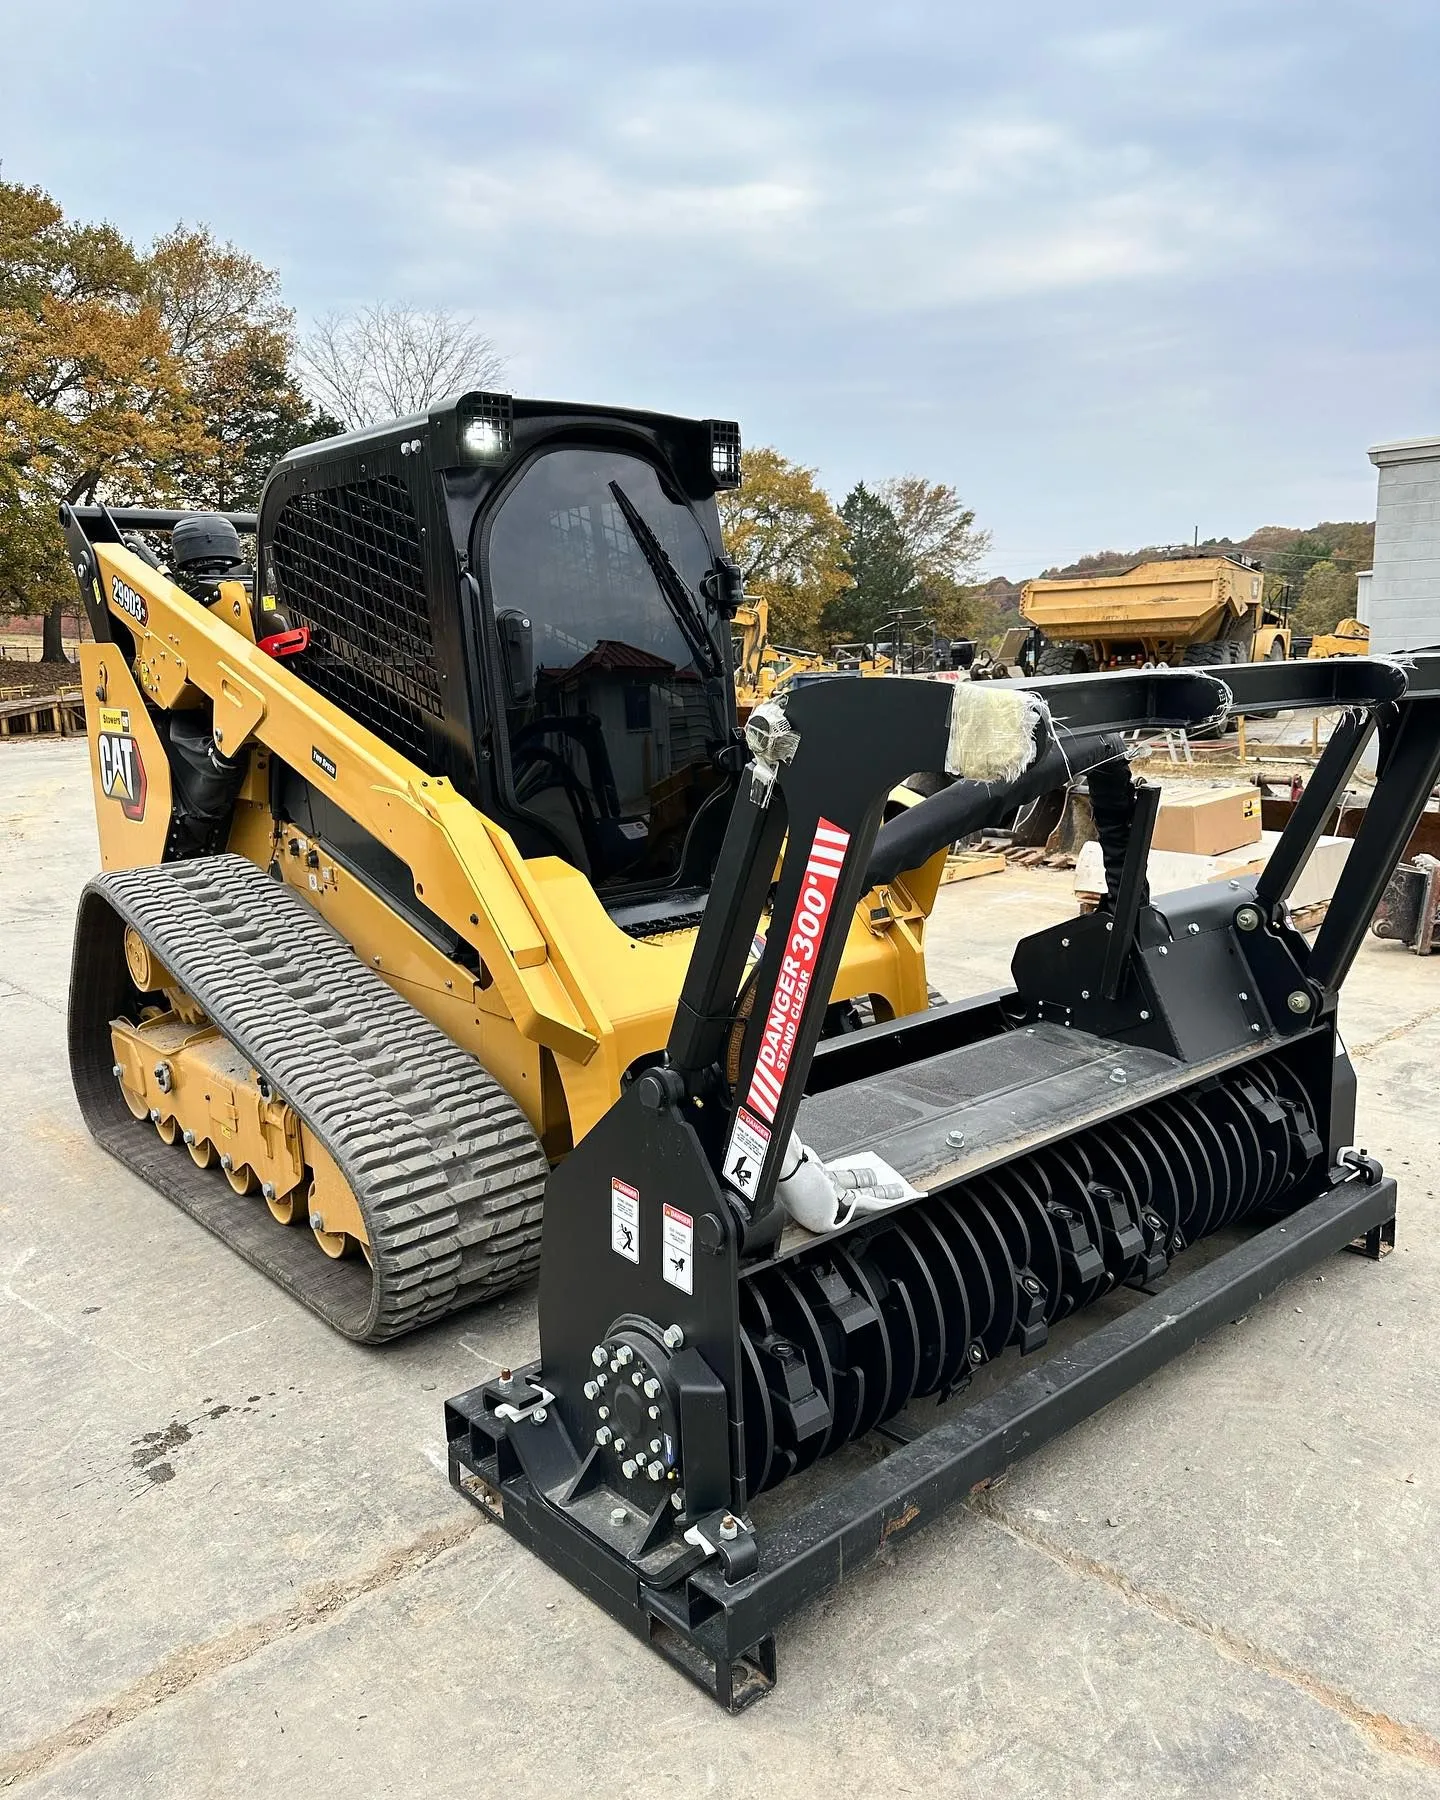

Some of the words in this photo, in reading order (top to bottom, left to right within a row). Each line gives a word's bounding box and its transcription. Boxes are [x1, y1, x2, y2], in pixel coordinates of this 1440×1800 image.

[112, 576, 142, 621] 299D3
[99, 735, 134, 800] CAT
[760, 955, 801, 1067] DANGER
[777, 1022, 796, 1072] STAND
[790, 969, 810, 1020] CLEAR
[745, 1116, 769, 1141] DANGER
